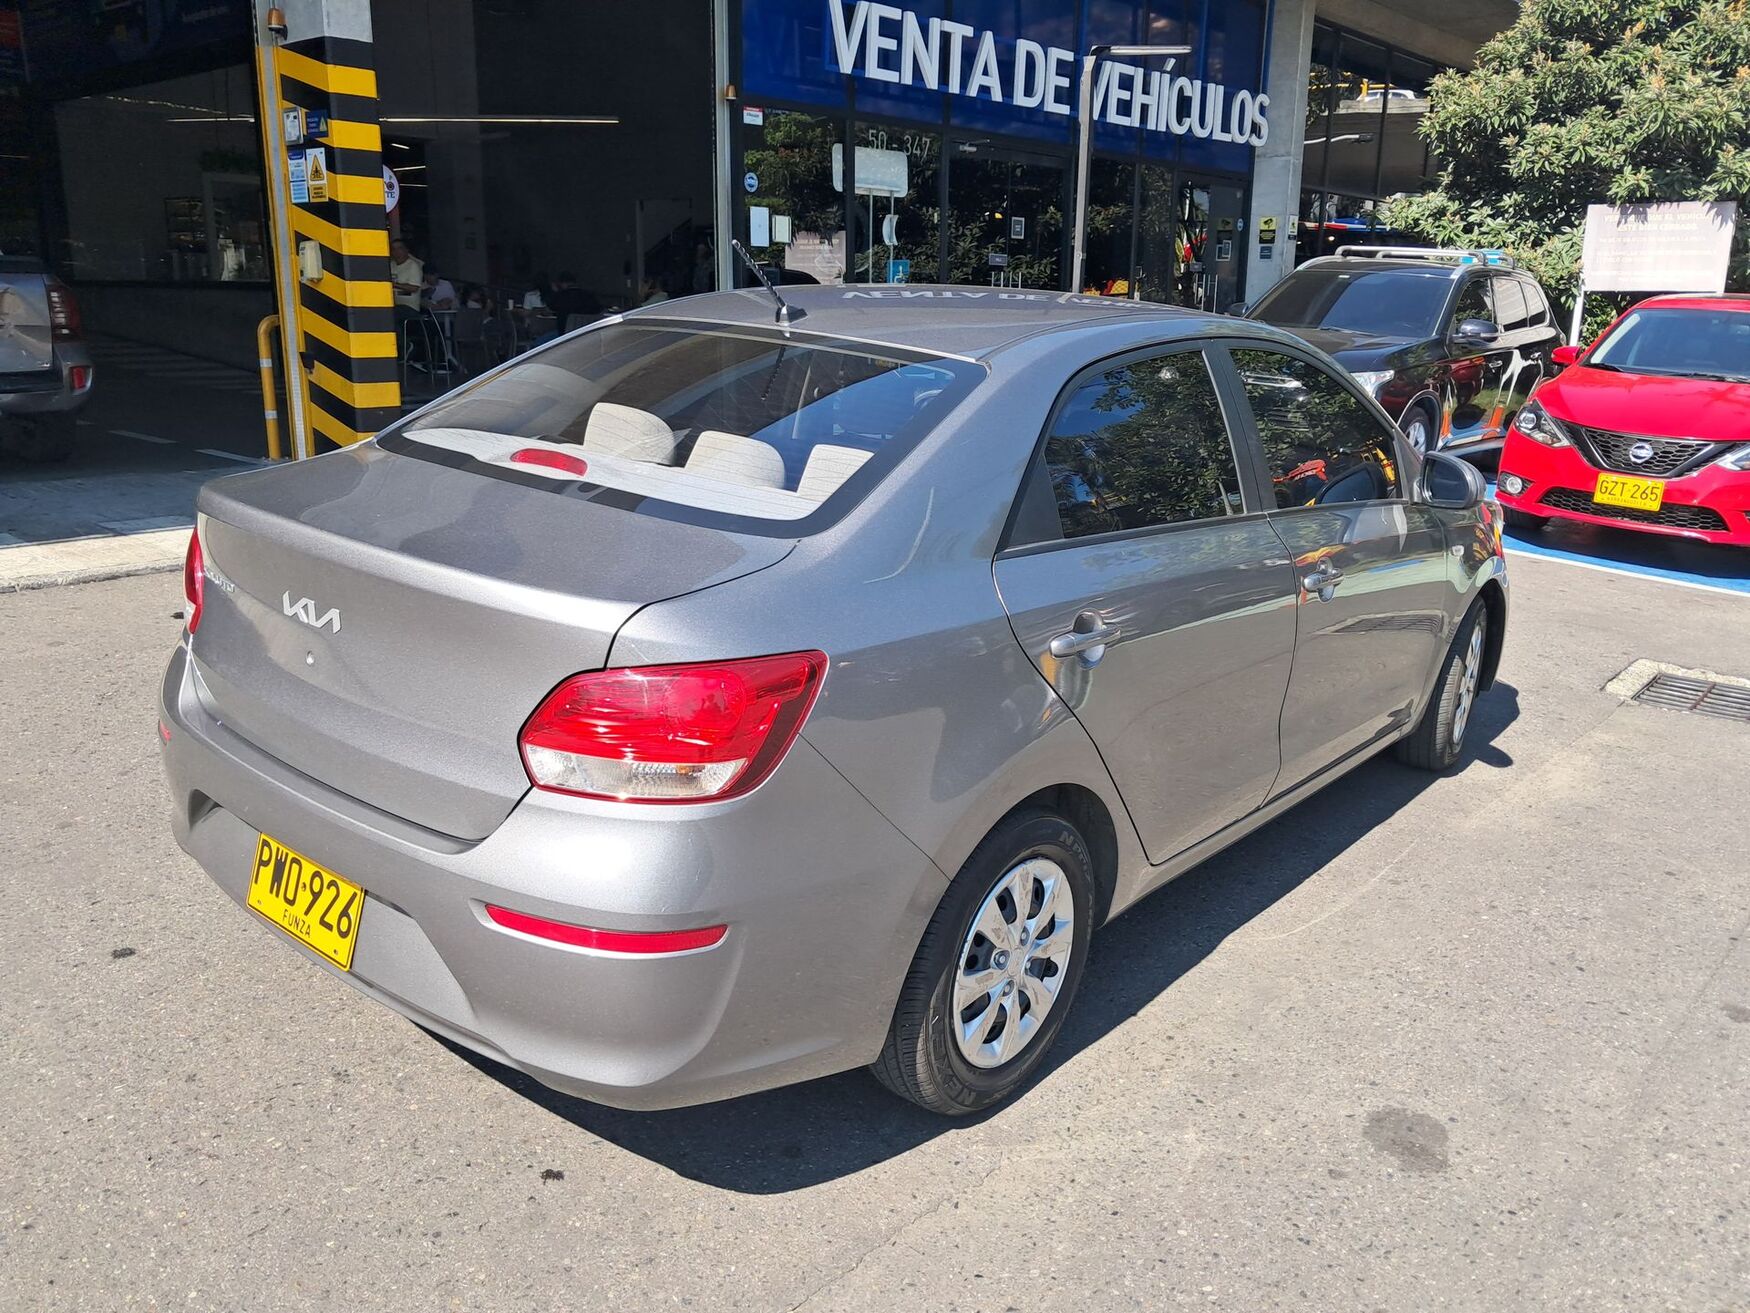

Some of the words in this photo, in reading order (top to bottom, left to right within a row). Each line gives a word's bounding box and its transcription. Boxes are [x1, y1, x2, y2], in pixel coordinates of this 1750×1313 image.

[829, 0, 1003, 102] VENTA
[1013, 38, 1075, 115] DE
[1093, 57, 1271, 147] VEHÍCULOS
[868, 129, 887, 151] 50
[903, 134, 931, 157] 347
[1599, 479, 1628, 497] GZT
[1630, 484, 1660, 502] 265
[282, 590, 341, 634] KIA
[282, 908, 312, 939] FUNZA
